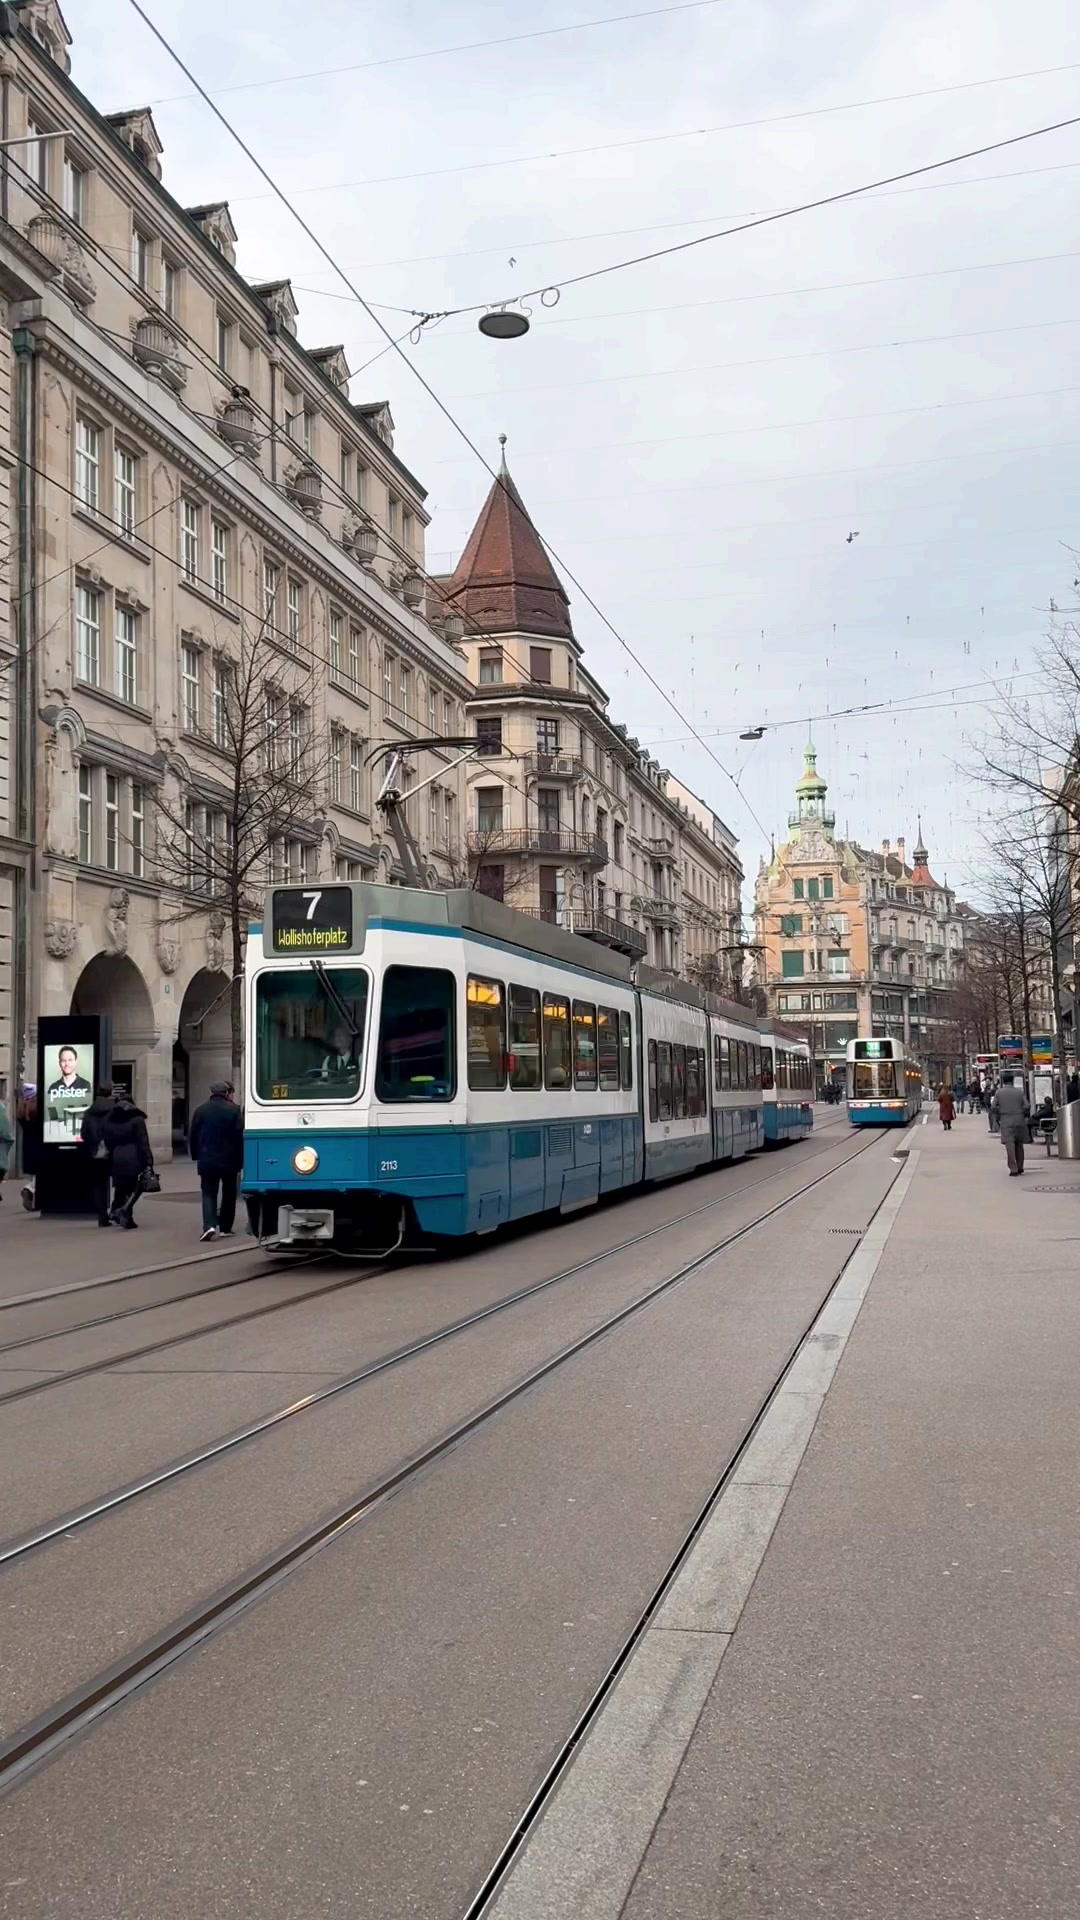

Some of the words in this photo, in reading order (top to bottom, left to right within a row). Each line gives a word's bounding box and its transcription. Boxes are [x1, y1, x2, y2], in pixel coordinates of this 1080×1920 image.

[302, 891, 322, 920] 7
[278, 926, 347, 948] Wollishoferplatz
[50, 1084, 88, 1102] pfister
[381, 1160, 398, 1171] 2113
